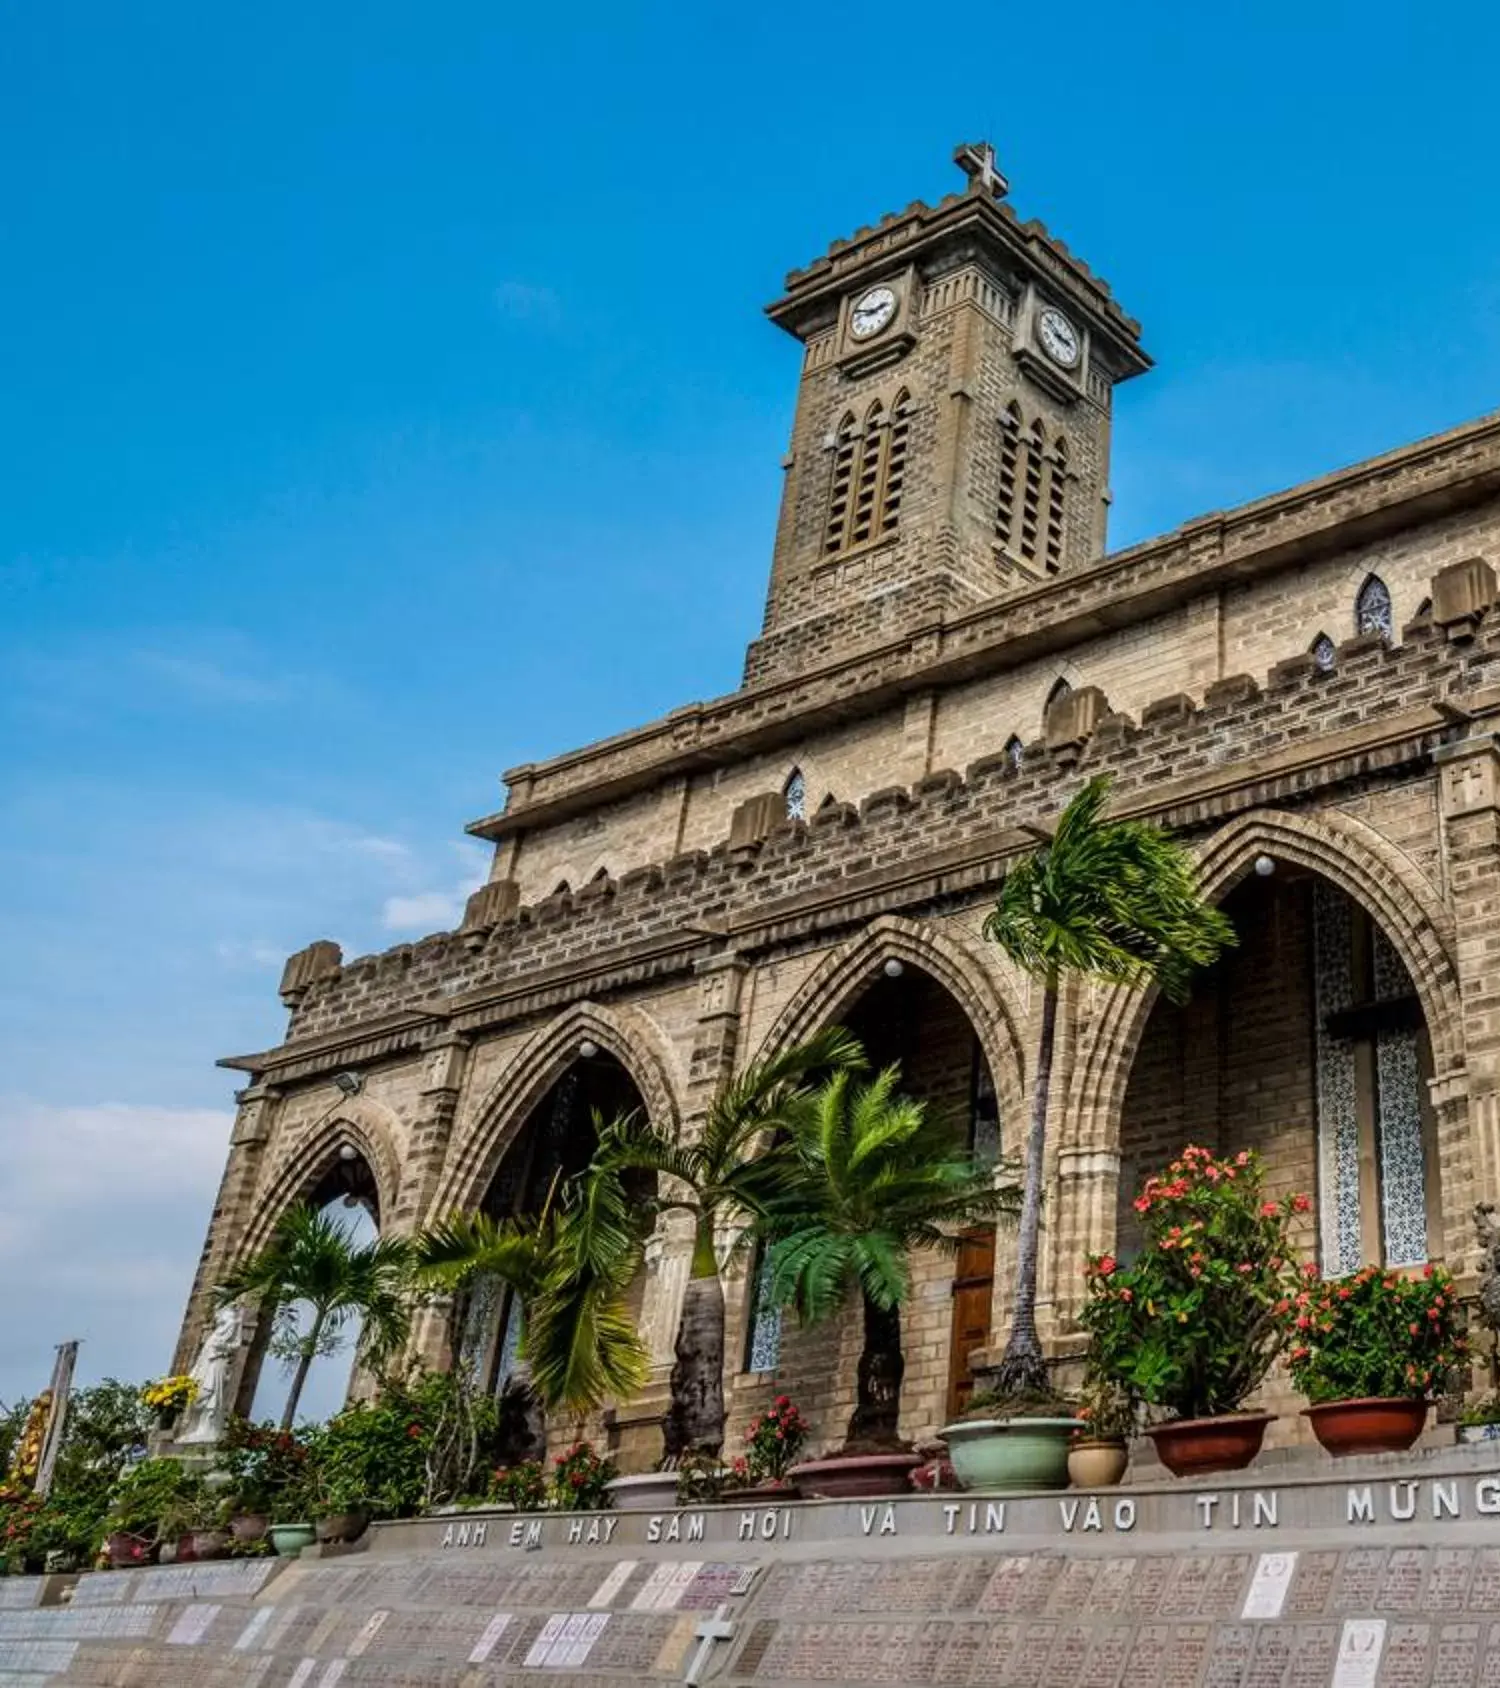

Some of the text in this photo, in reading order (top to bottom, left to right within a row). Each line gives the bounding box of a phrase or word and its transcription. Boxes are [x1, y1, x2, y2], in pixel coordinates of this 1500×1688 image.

[442, 1521, 487, 1547] ANH
[509, 1520, 543, 1546] EM
[943, 1502, 1006, 1534] TIN
[1196, 1491, 1280, 1528] TIN
